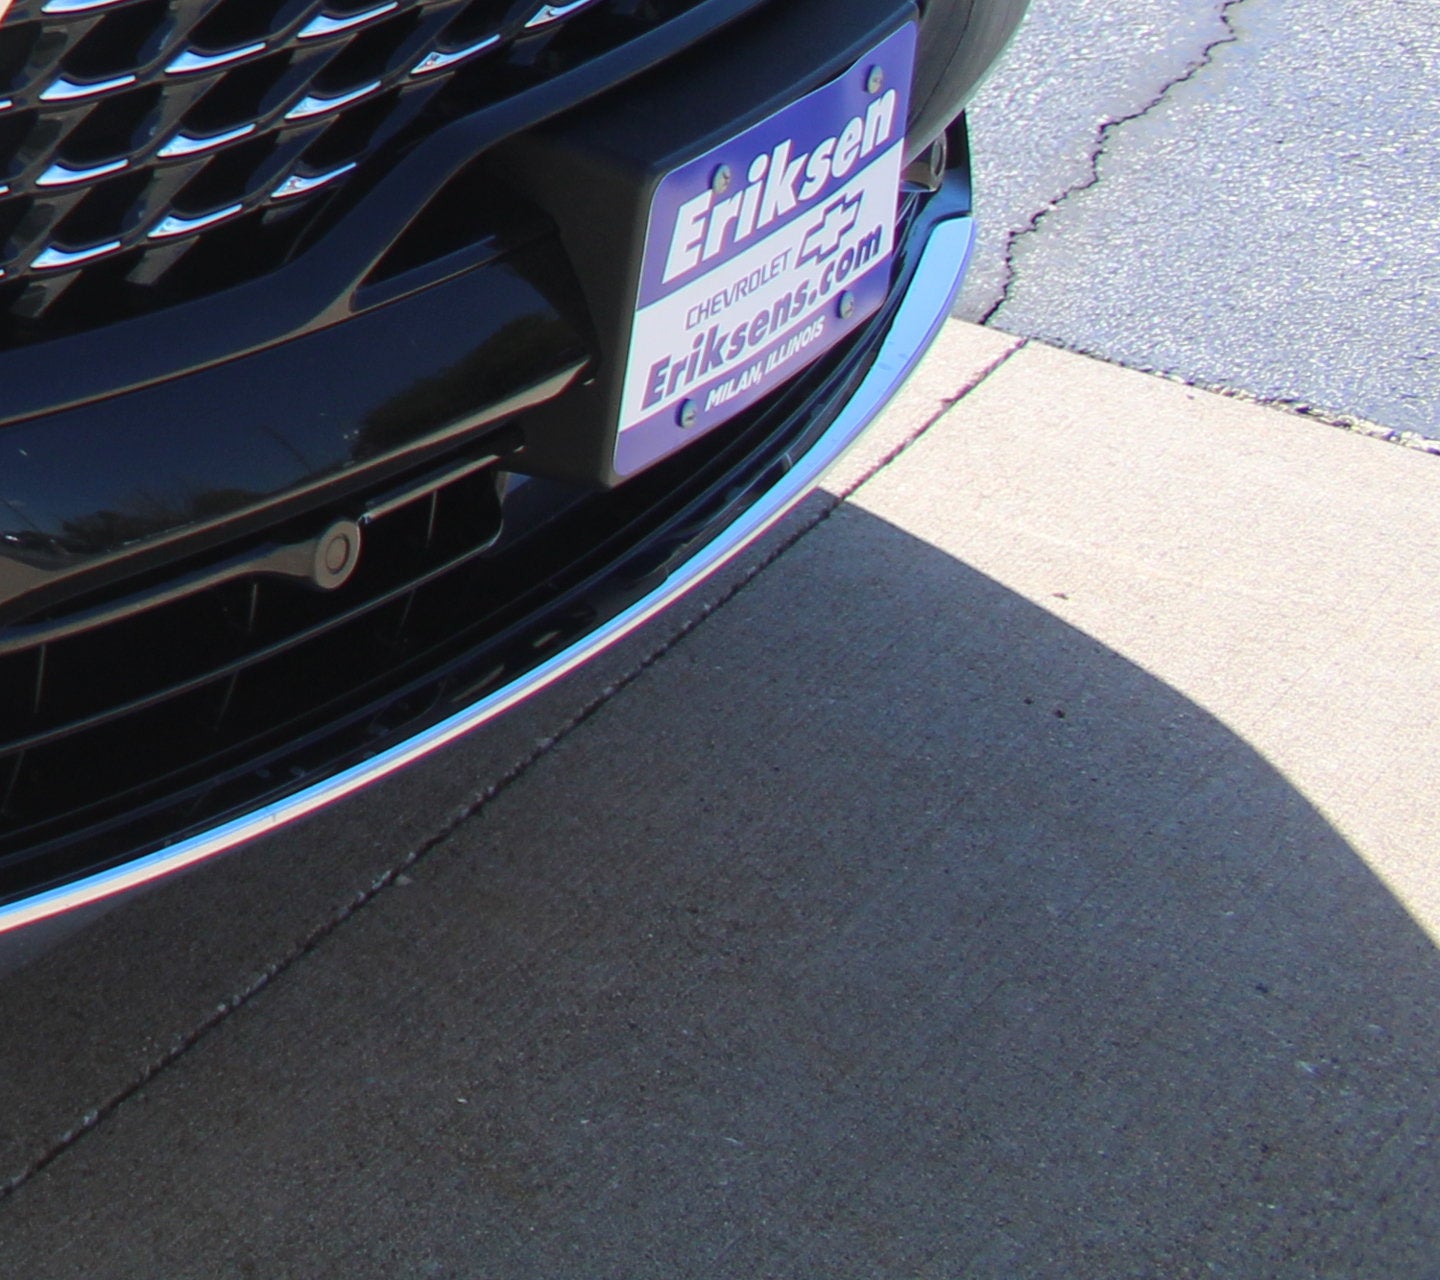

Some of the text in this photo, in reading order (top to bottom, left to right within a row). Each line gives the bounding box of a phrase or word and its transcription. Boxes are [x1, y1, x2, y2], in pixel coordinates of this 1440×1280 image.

[662, 89, 896, 284] Eriksen
[641, 224, 882, 411] Eriksens.com
[685, 247, 794, 331] CHEVROLET
[705, 315, 826, 412] MILAN, ILLINOIS
